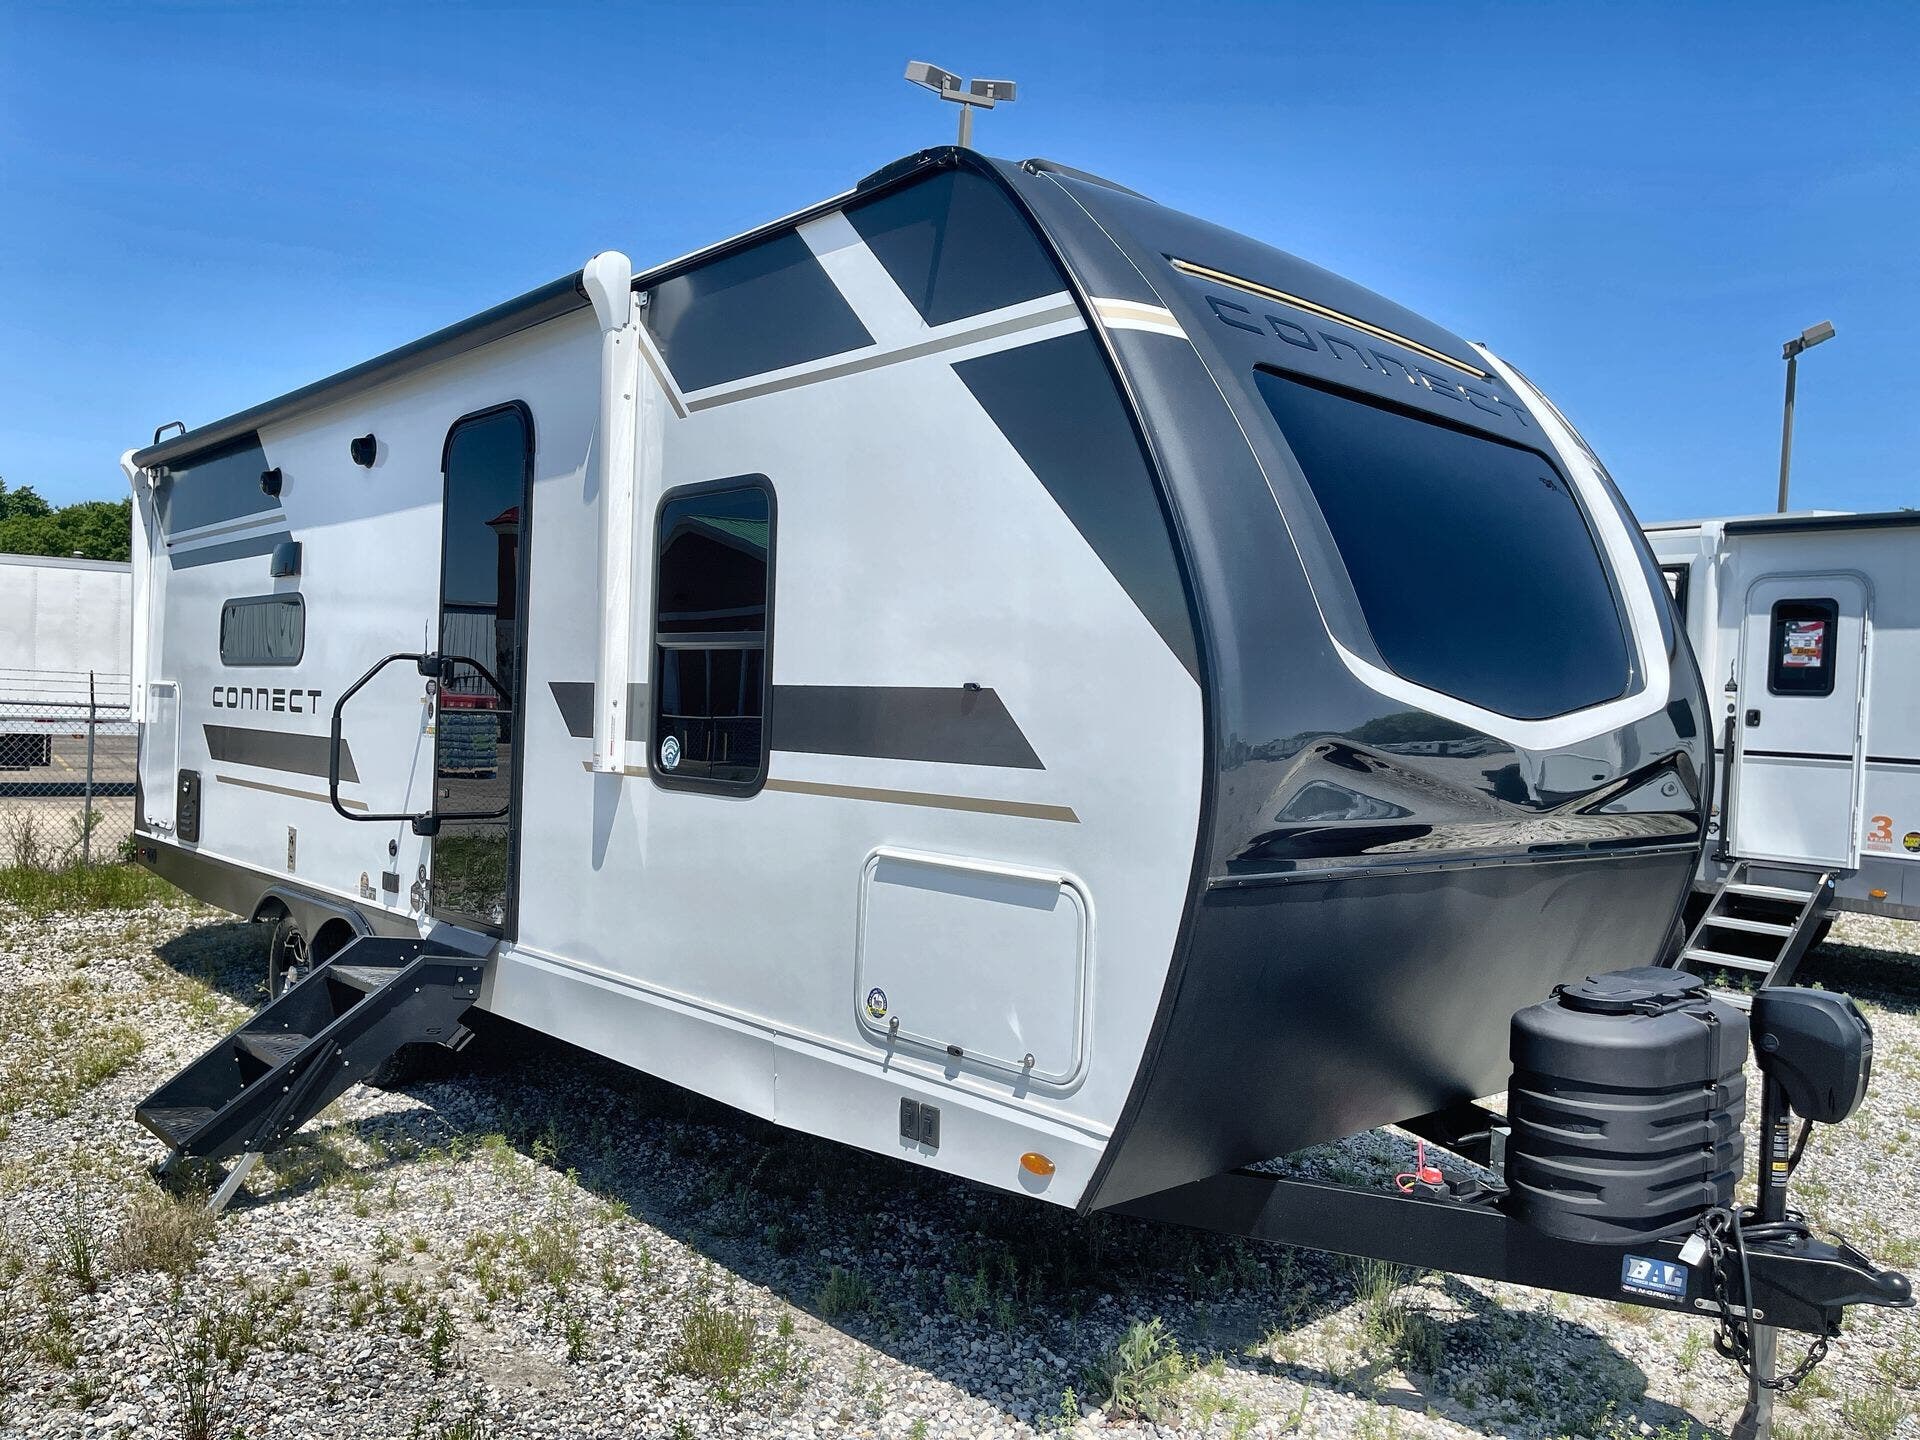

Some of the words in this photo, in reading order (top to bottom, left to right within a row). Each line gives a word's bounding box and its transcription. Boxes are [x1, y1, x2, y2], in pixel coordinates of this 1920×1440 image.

[1205, 296, 1527, 427] CONNECT
[212, 686, 322, 714] CONNECT
[1867, 815, 1893, 839] 3
